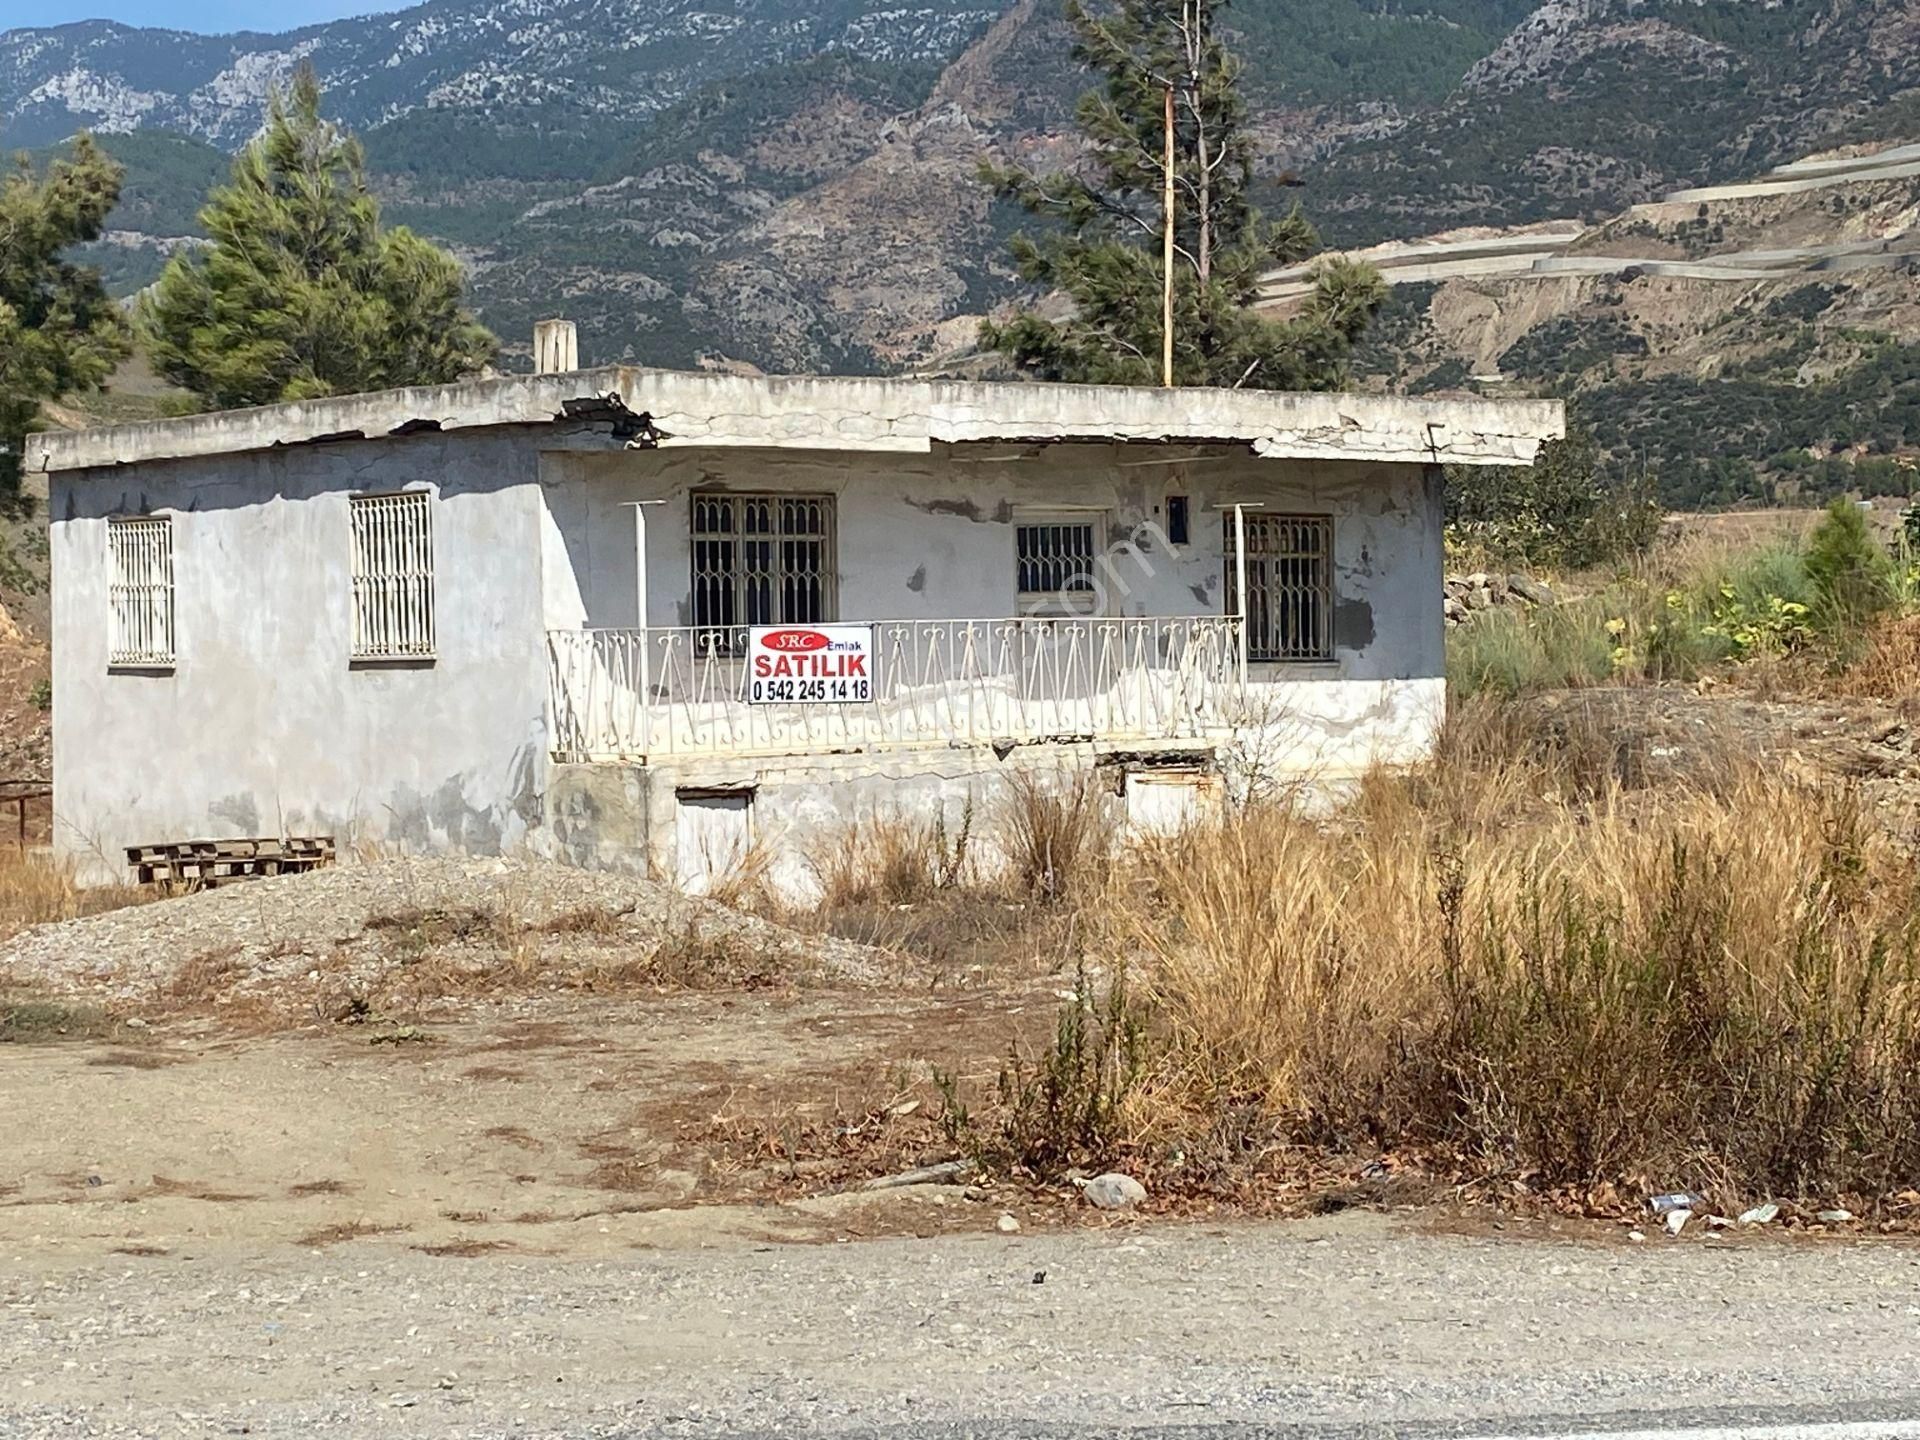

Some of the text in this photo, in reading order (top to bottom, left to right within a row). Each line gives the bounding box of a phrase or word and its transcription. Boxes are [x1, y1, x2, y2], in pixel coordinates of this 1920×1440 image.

[776, 634, 862, 652] SRC Emlak
[754, 654, 867, 678] SATILIK
[753, 679, 868, 701] 0 542 245 14 18
